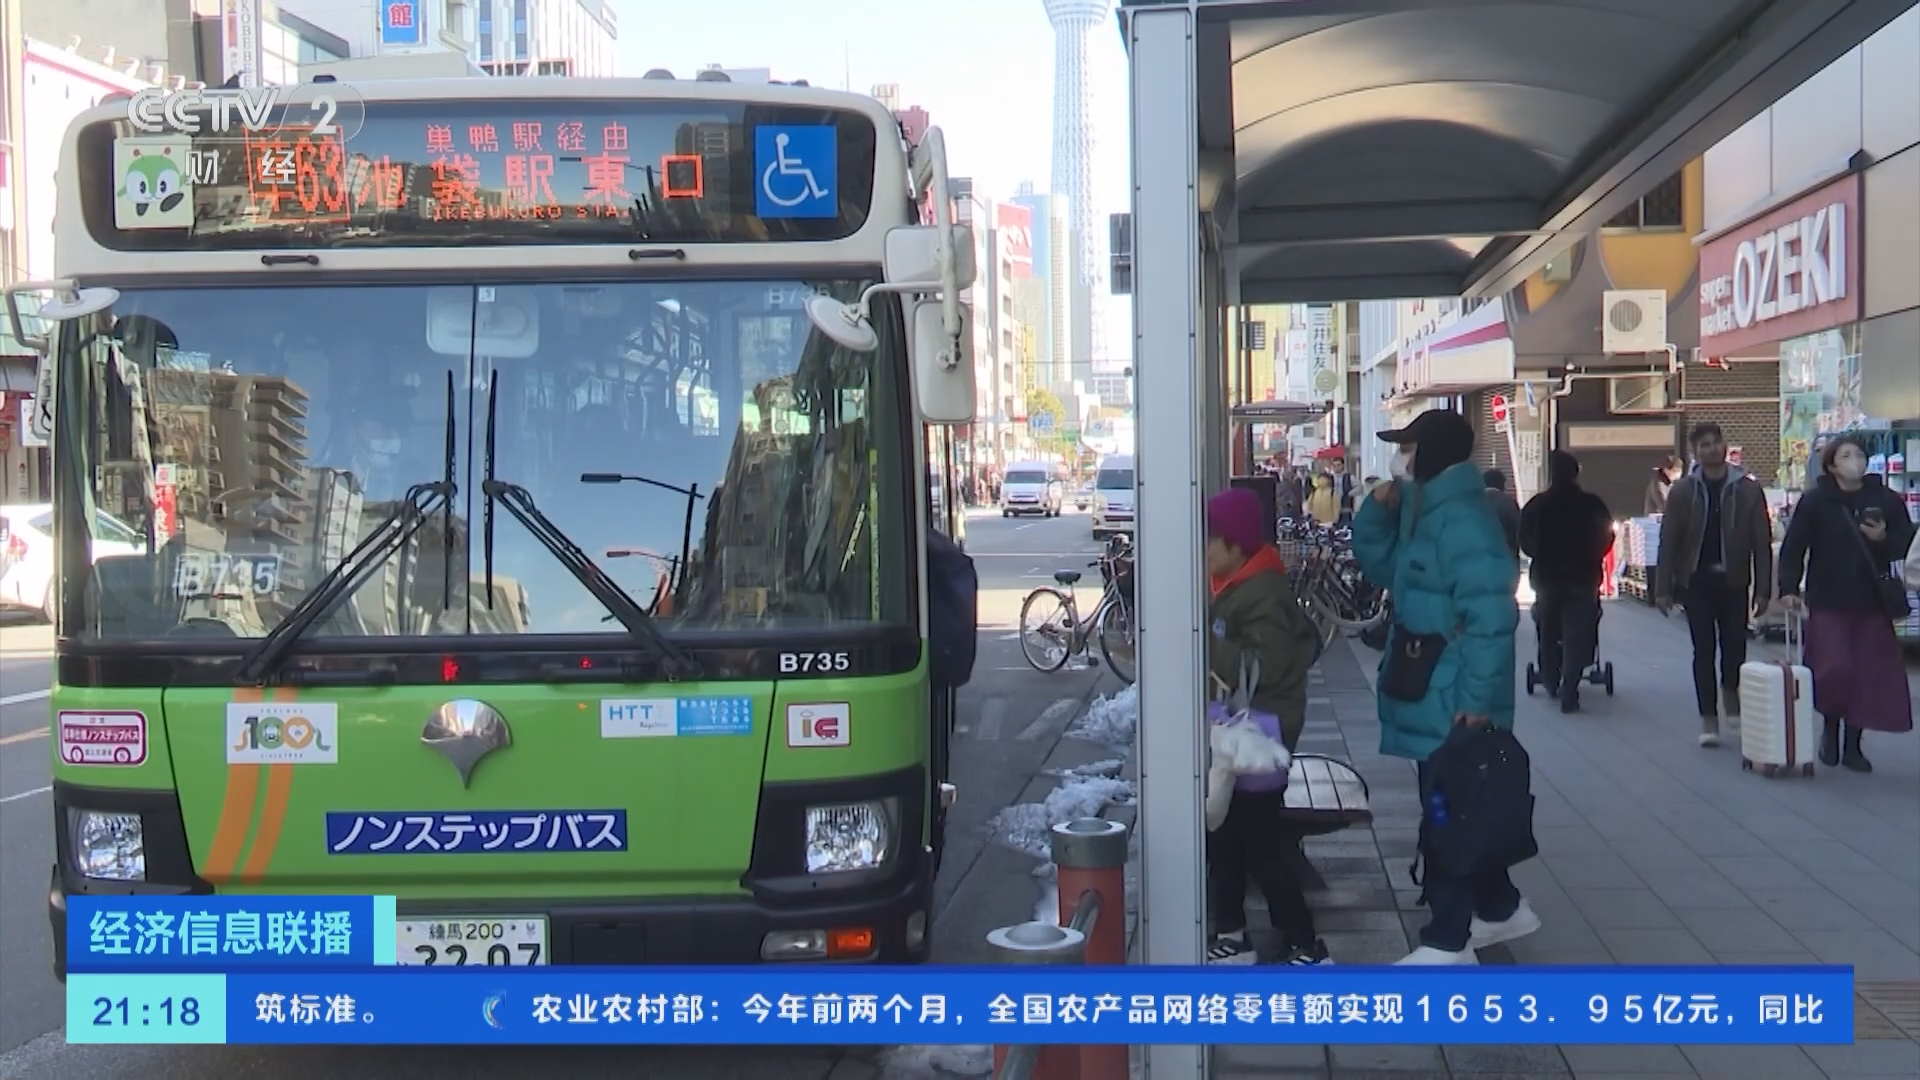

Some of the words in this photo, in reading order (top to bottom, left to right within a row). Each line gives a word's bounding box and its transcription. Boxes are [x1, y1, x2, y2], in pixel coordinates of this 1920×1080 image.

[388, 4, 414, 28] 館
[426, 121, 628, 152] 巣鴨駅経由
[356, 152, 704, 206] 池袋駅東口
[433, 205, 562, 221] IKEBUKURO
[1733, 203, 1846, 328] OZEKI
[780, 652, 849, 673] B735
[333, 813, 623, 851] ノンステップバス
